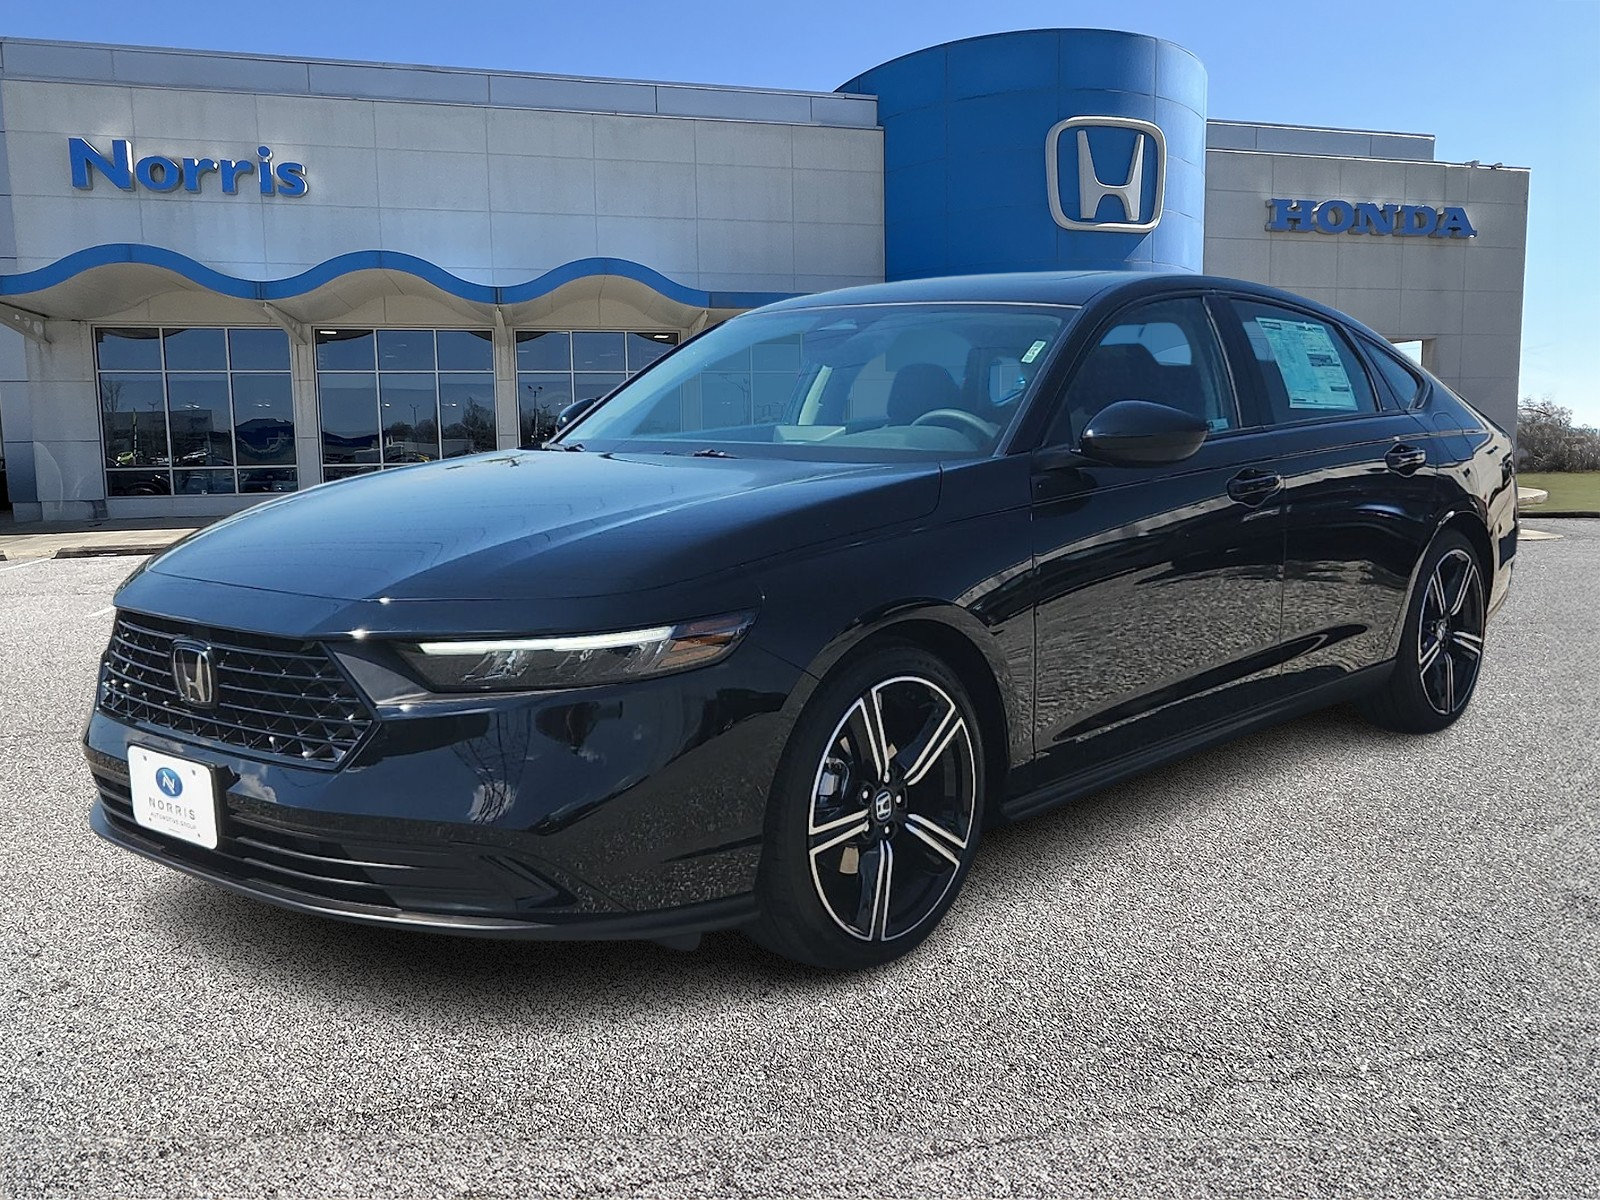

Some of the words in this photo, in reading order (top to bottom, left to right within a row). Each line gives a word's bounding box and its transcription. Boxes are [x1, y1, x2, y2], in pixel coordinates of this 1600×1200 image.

[68, 137, 309, 197] Norris
[1265, 198, 1478, 239] HONDA
[148, 796, 195, 821] NORRIS
